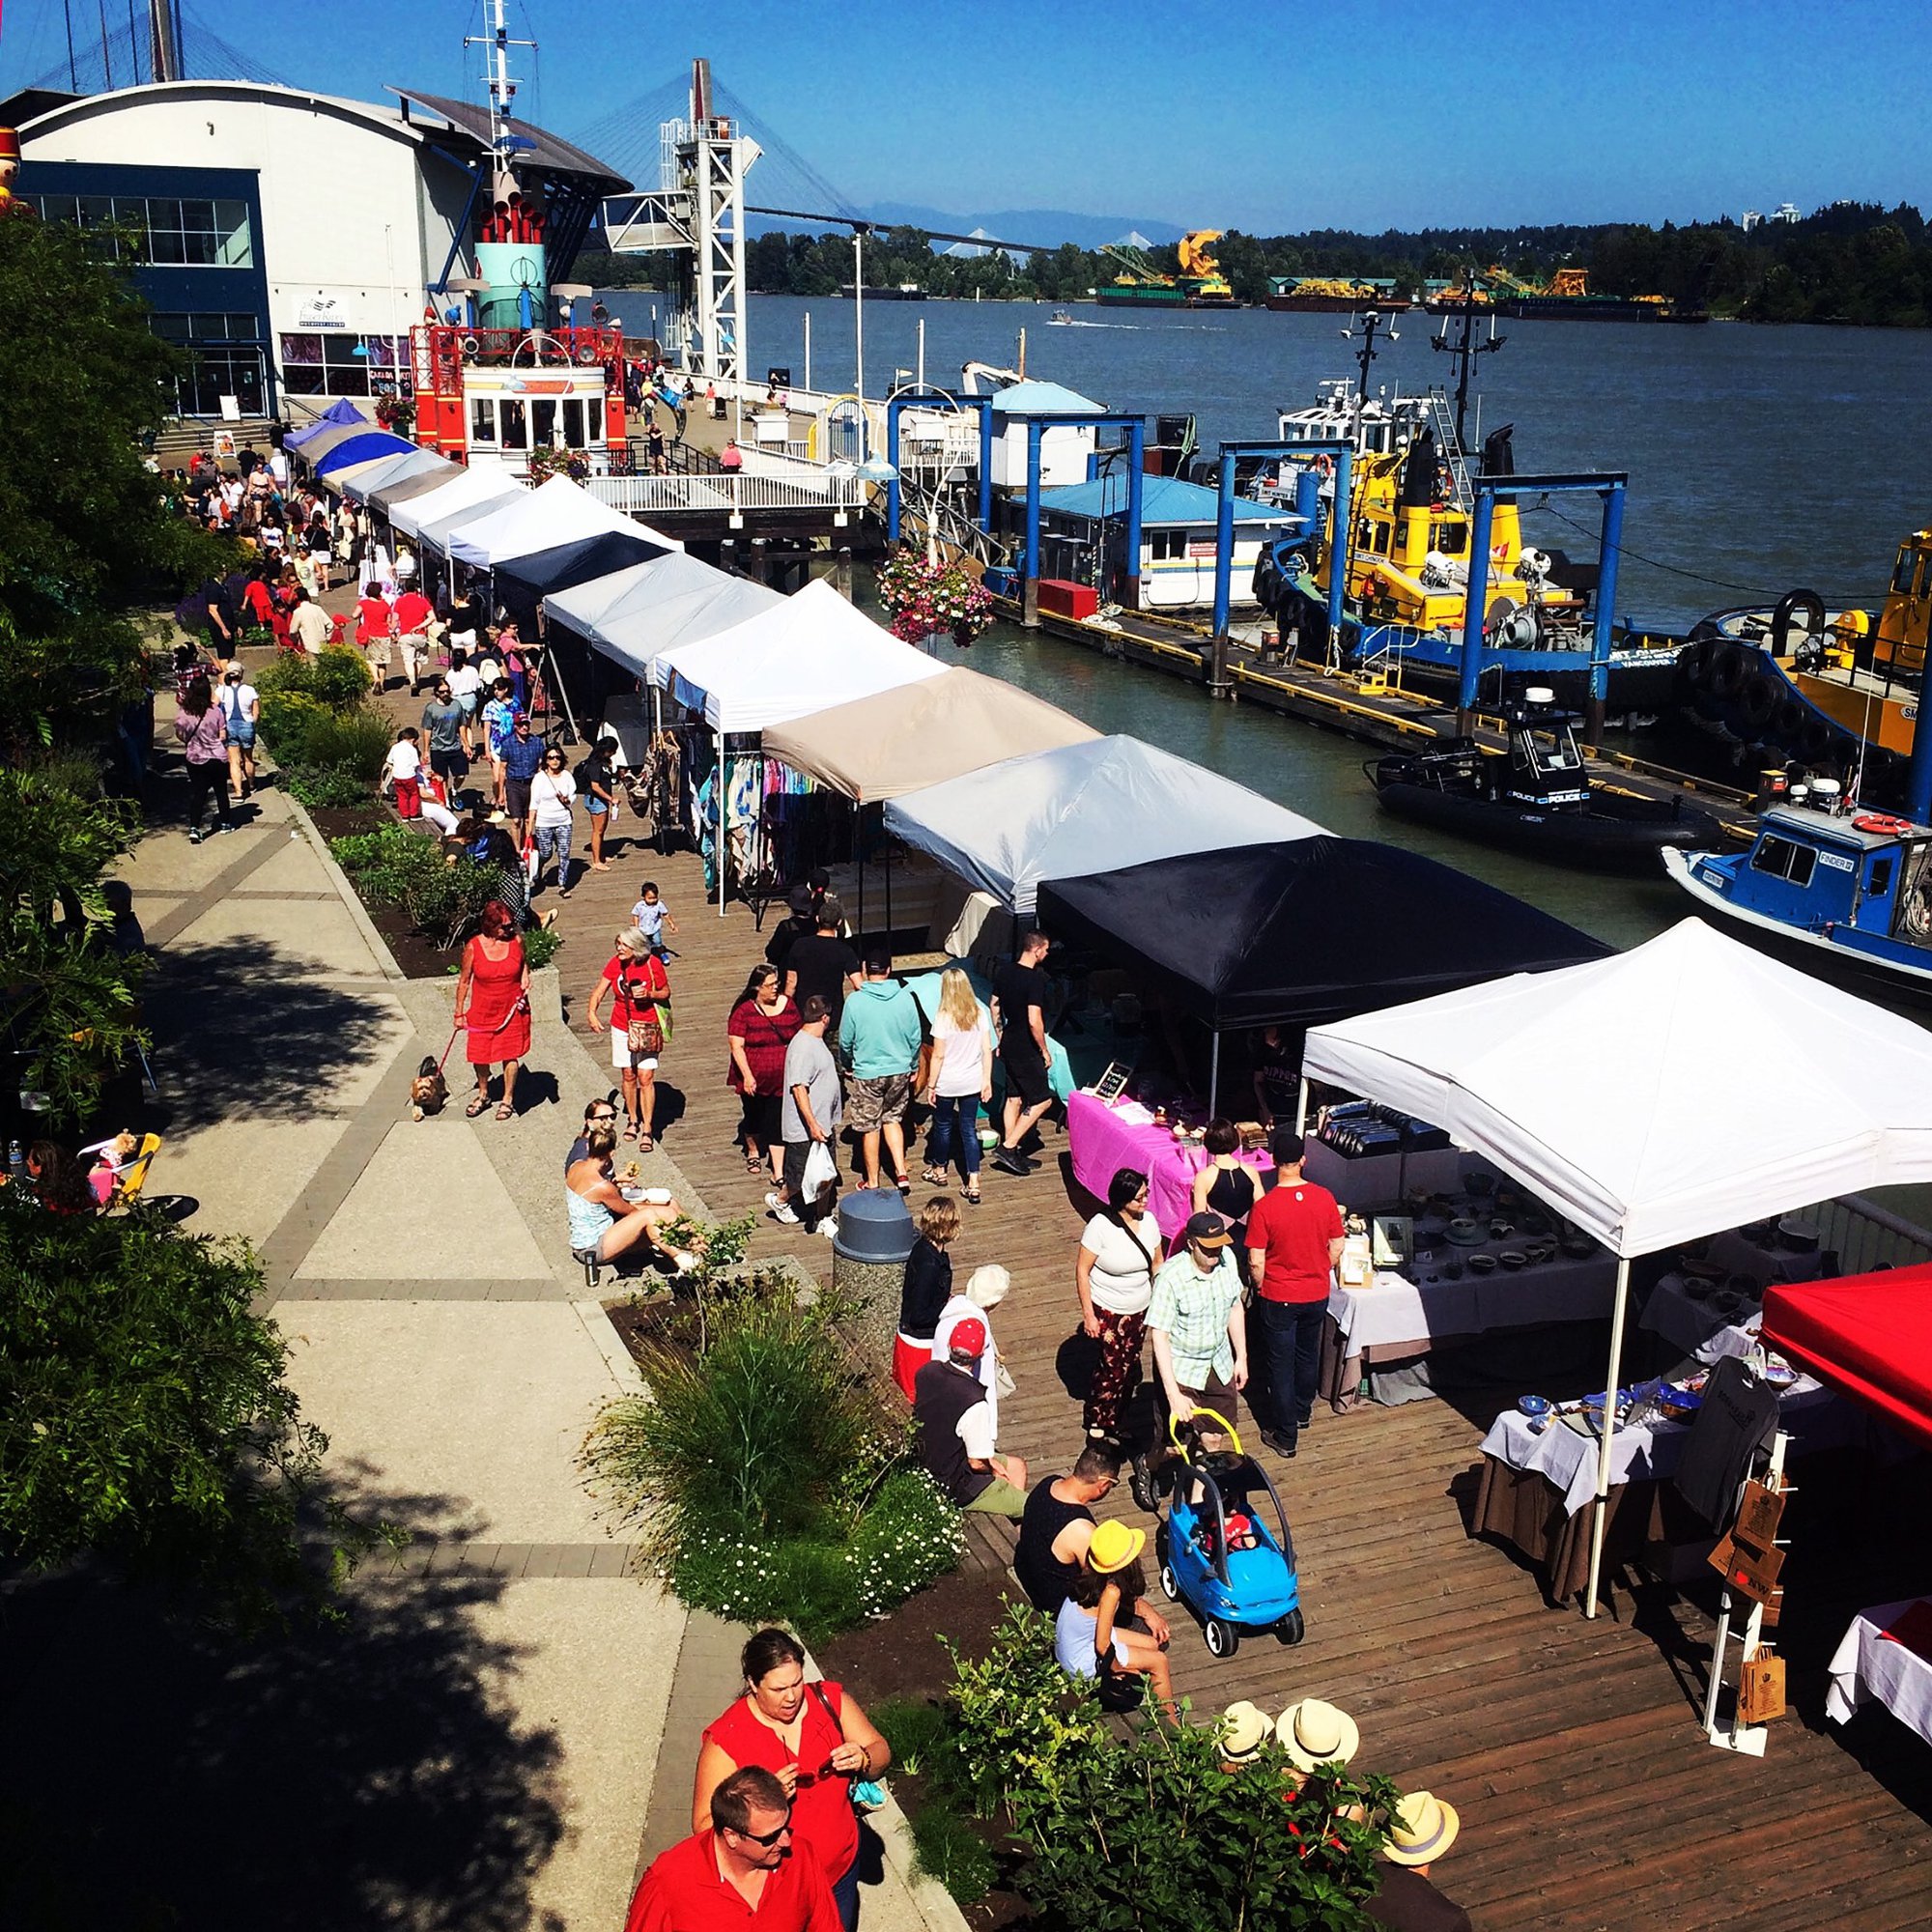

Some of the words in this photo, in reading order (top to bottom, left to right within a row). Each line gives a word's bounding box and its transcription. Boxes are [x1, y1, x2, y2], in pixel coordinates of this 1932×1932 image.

[1512, 790, 1535, 803] POLICE
[1548, 793, 1581, 804] POLICE
[1820, 851, 1845, 868] FINDER
[1747, 1576, 1770, 1595] NW
